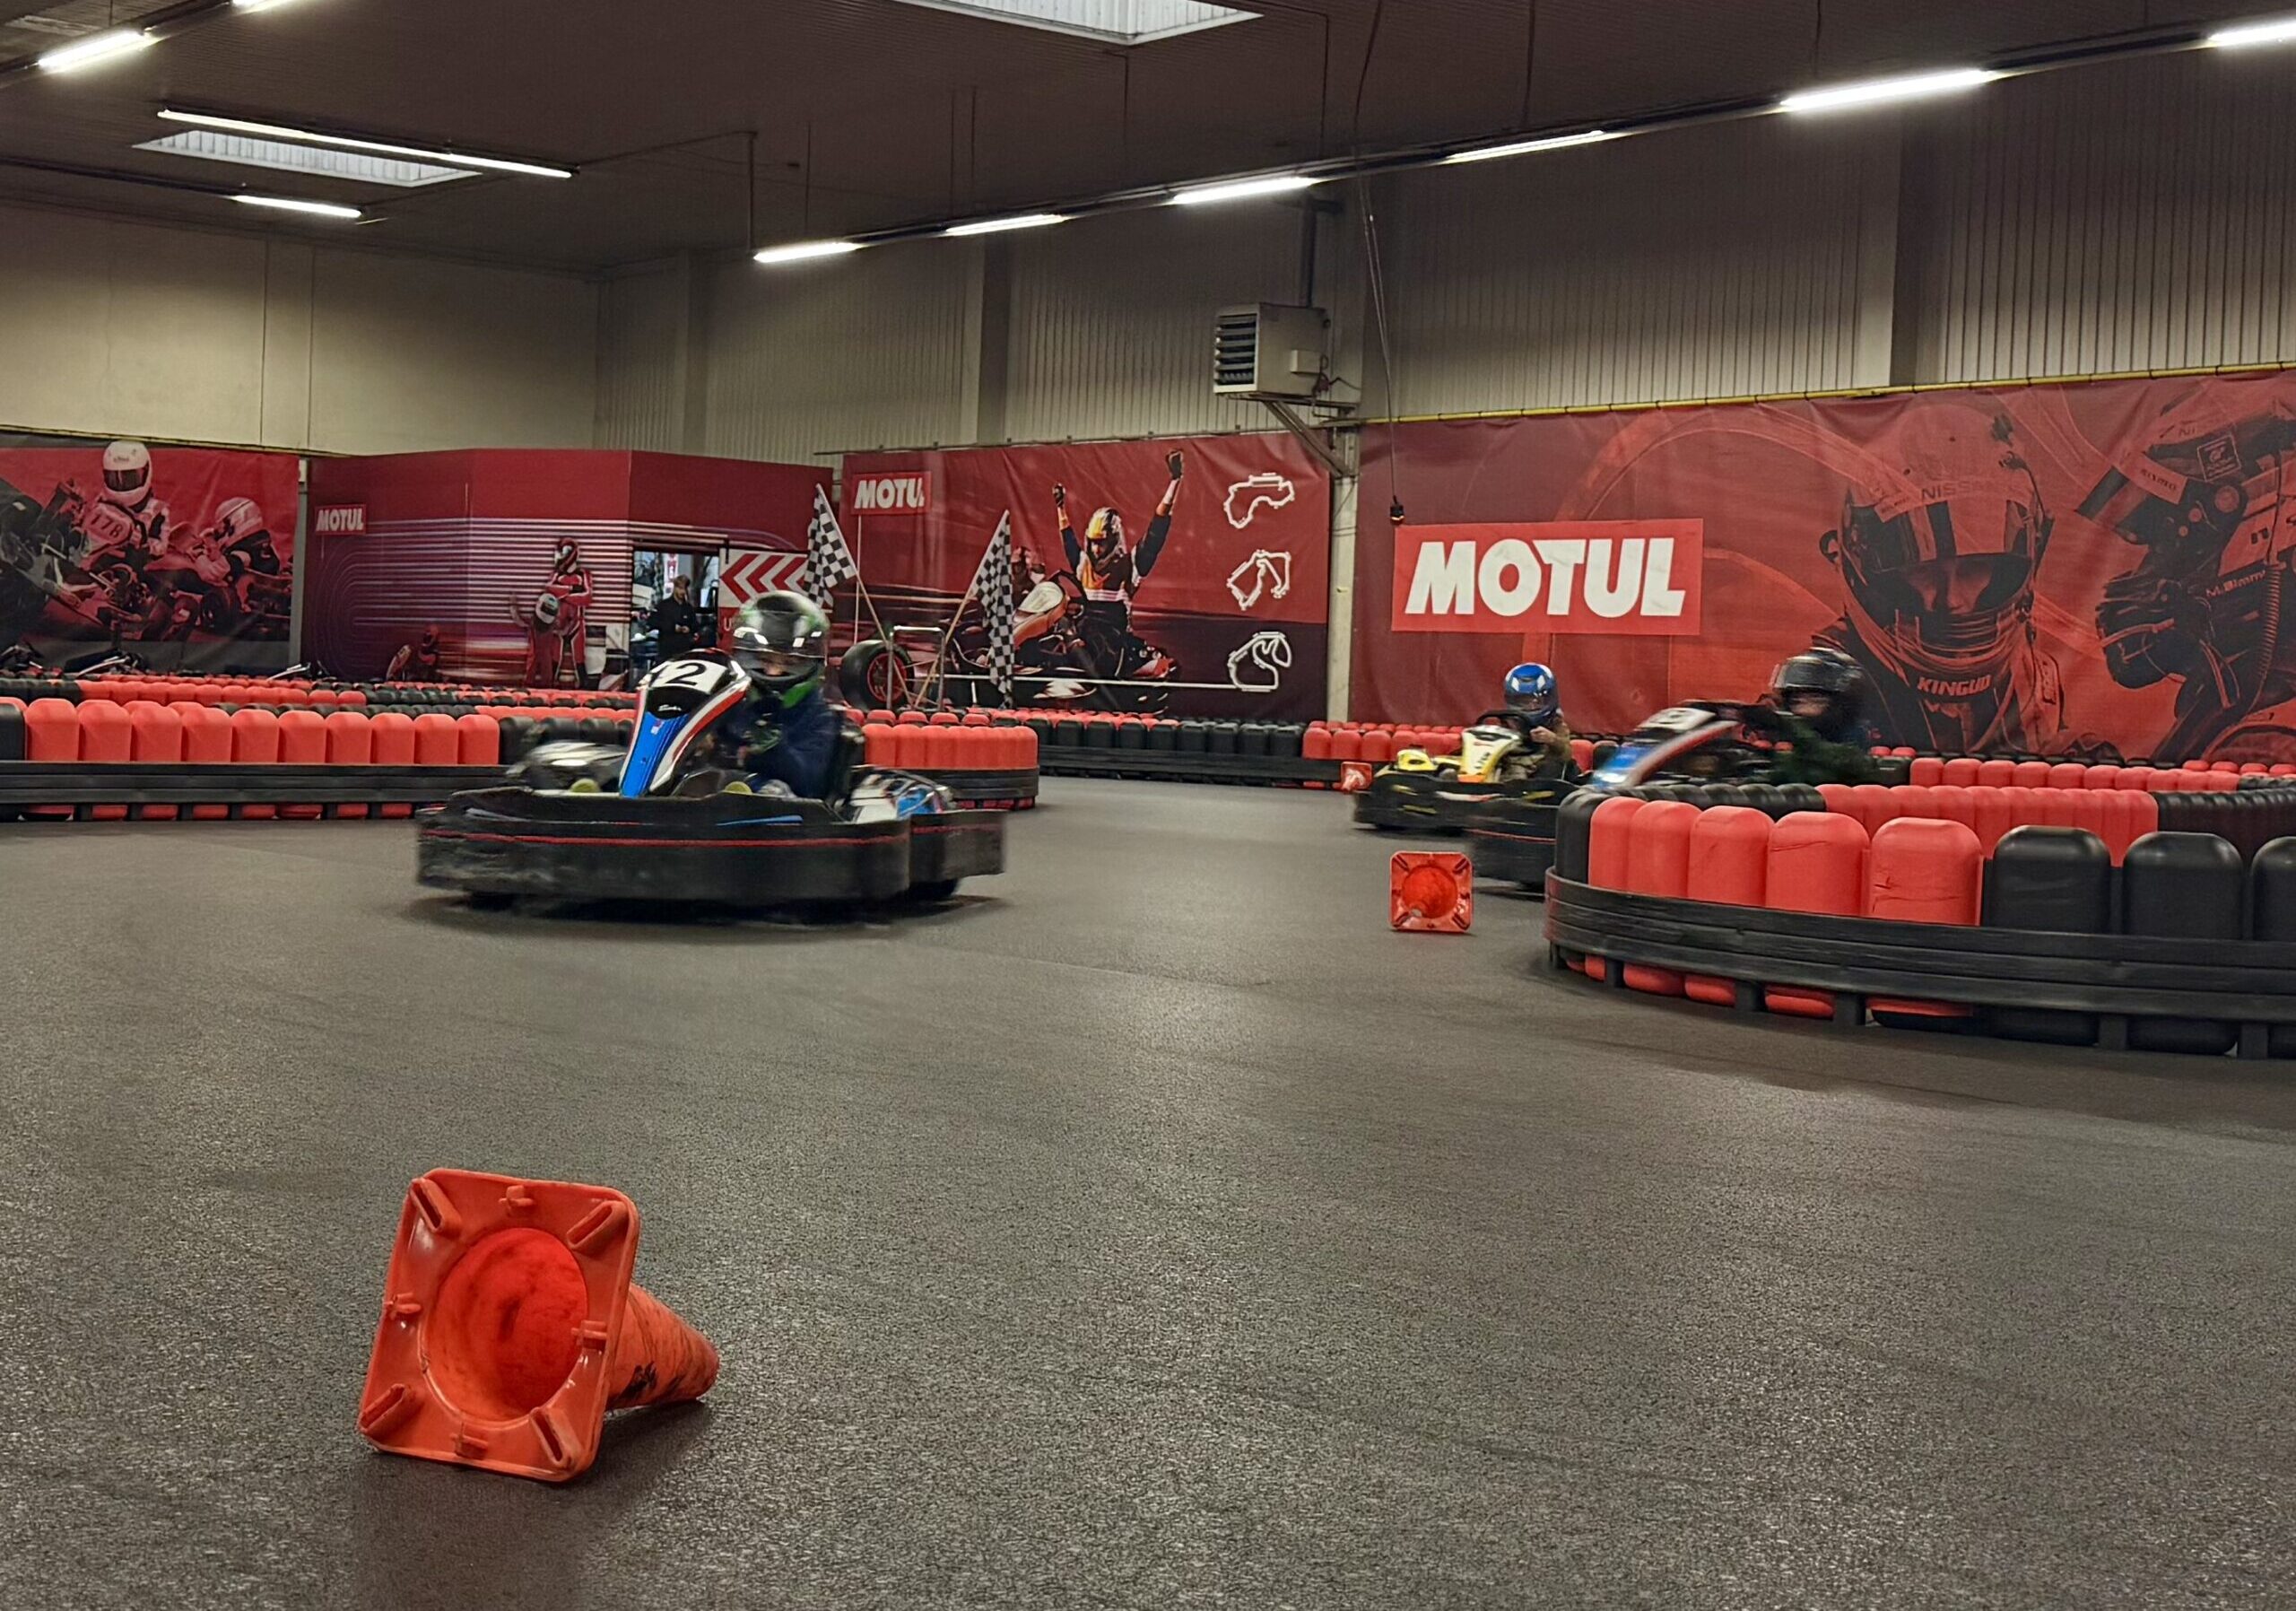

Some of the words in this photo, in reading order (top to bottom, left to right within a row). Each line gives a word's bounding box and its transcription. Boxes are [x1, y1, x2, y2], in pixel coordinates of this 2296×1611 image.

[1921, 480, 1996, 501] NISS
[316, 508, 364, 532] MOTUL
[1405, 537, 1686, 618] MOTUL
